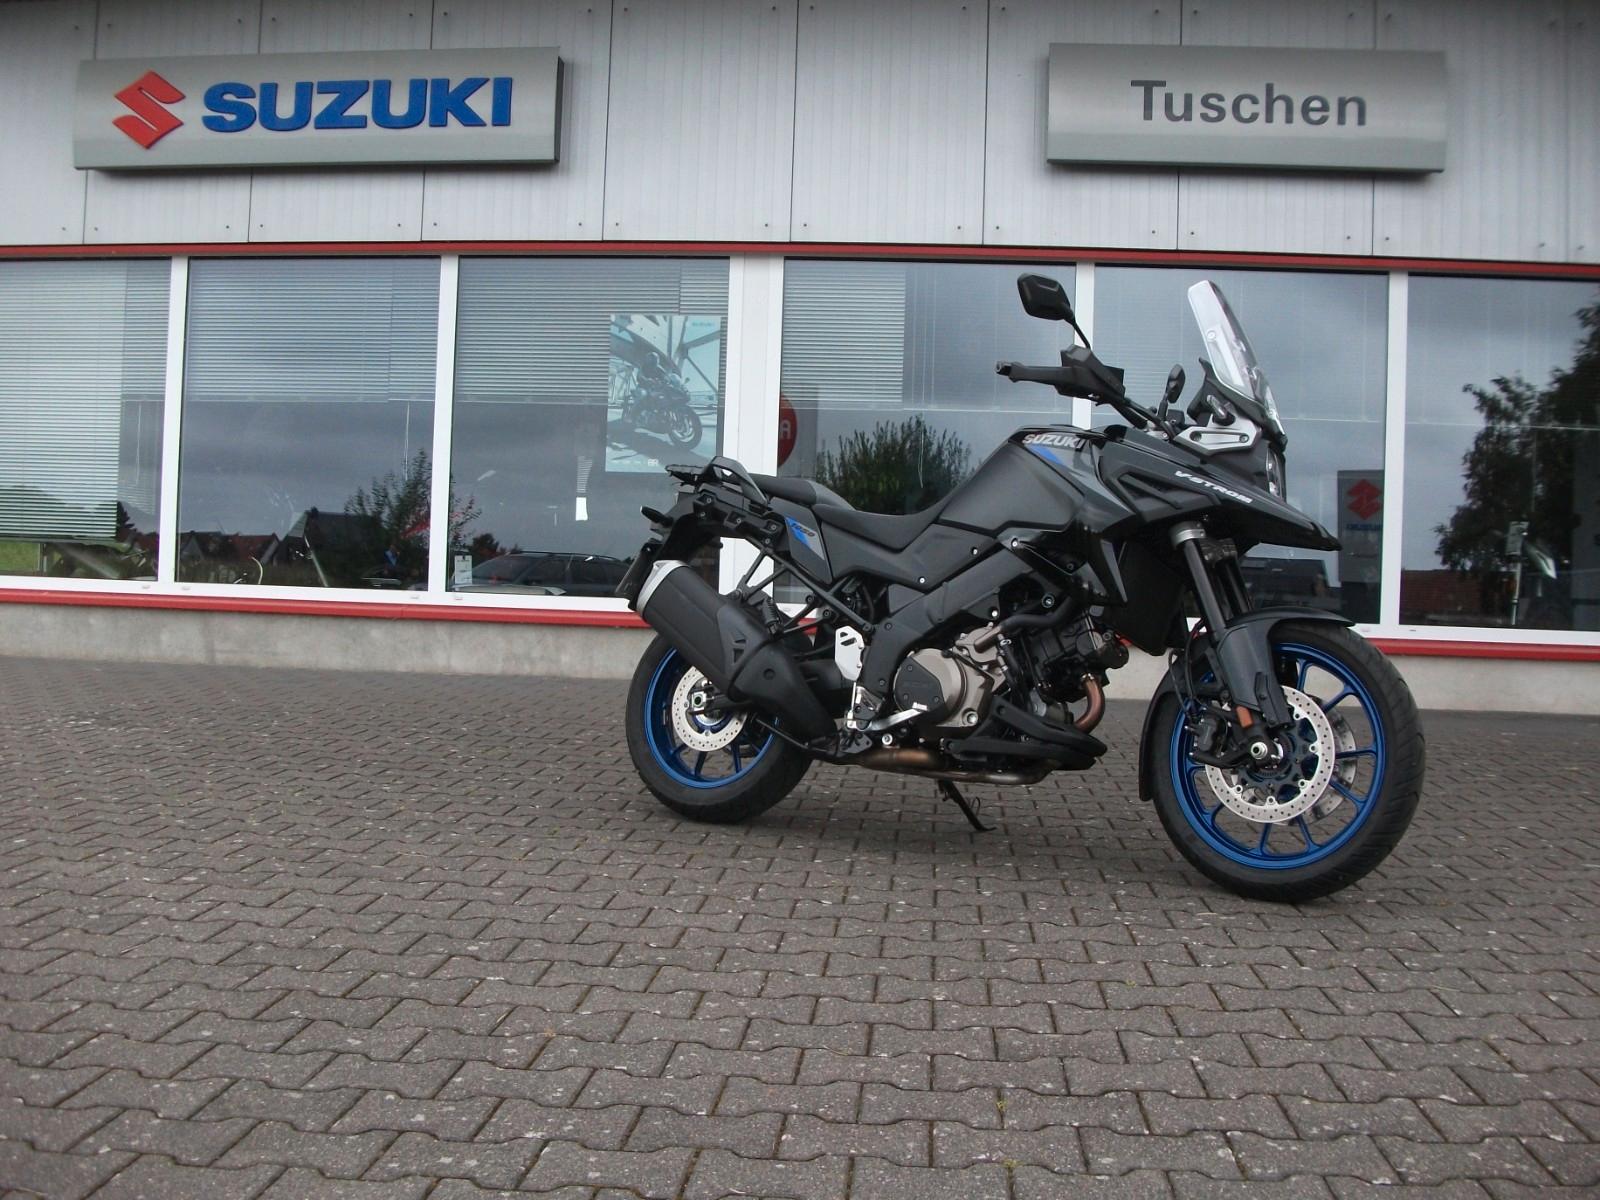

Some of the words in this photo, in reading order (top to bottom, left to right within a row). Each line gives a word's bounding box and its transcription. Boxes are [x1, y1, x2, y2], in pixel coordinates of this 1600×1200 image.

[202, 77, 513, 133] SUZUKI
[1130, 79, 1367, 126] Tuschen
[1022, 431, 1086, 449] SUZUKI
